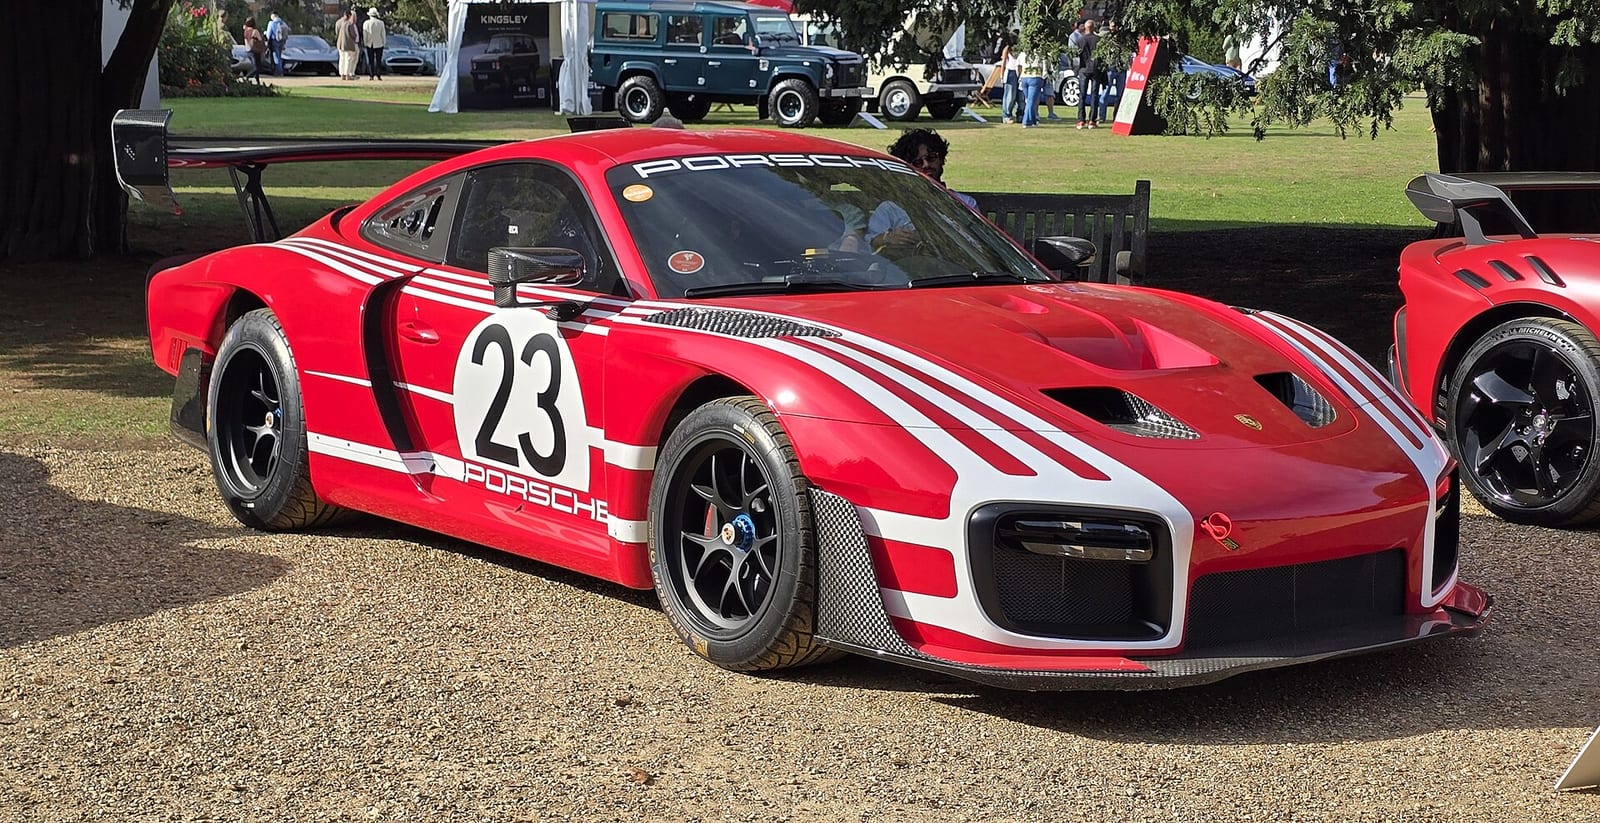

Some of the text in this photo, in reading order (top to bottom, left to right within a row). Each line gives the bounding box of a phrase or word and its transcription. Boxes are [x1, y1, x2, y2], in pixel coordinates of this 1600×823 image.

[480, 15, 528, 24] KINGSLEY
[632, 154, 919, 179] PORSCHE
[471, 323, 567, 478] 23
[464, 462, 608, 524] PORSCHE
